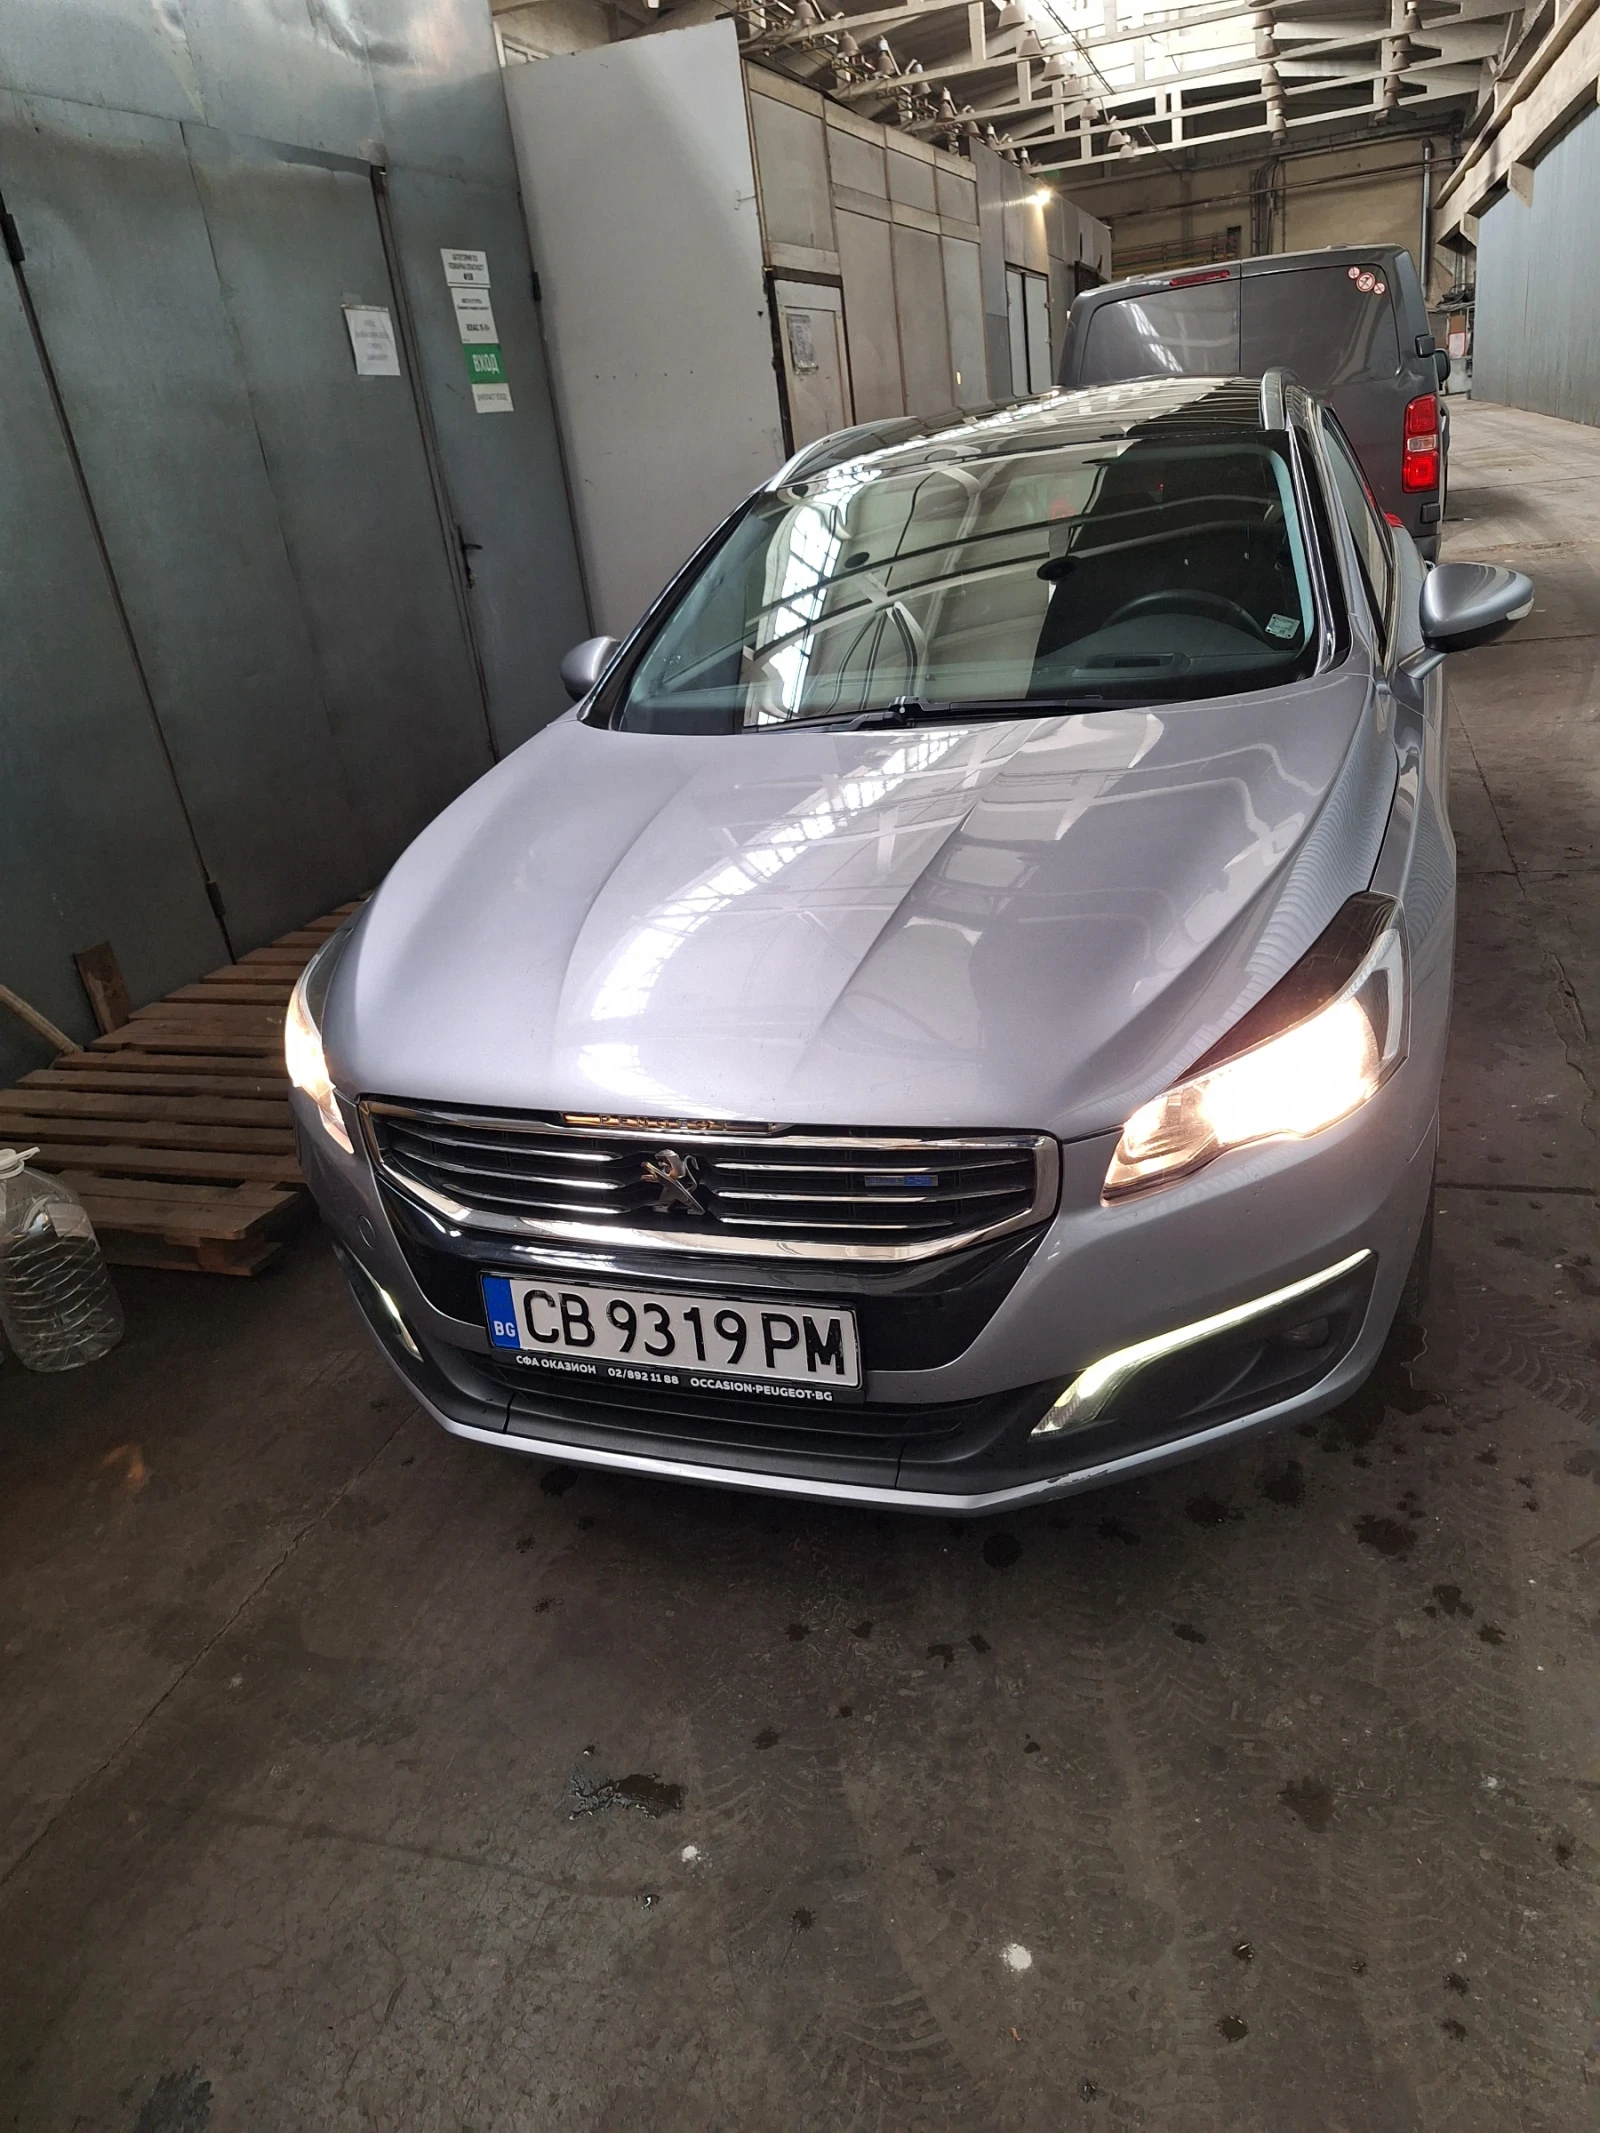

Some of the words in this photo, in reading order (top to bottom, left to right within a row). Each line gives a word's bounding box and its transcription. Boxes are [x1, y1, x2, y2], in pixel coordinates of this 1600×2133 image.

[472, 353, 500, 375] ВХОД
[493, 1320, 516, 1338] BG
[516, 1355, 539, 1367] СФА
[541, 1359, 597, 1375] ОКАЗИОН
[607, 1367, 649, 1381] 02/892
[650, 1373, 662, 1383] 11
[664, 1374, 679, 1385] 88
